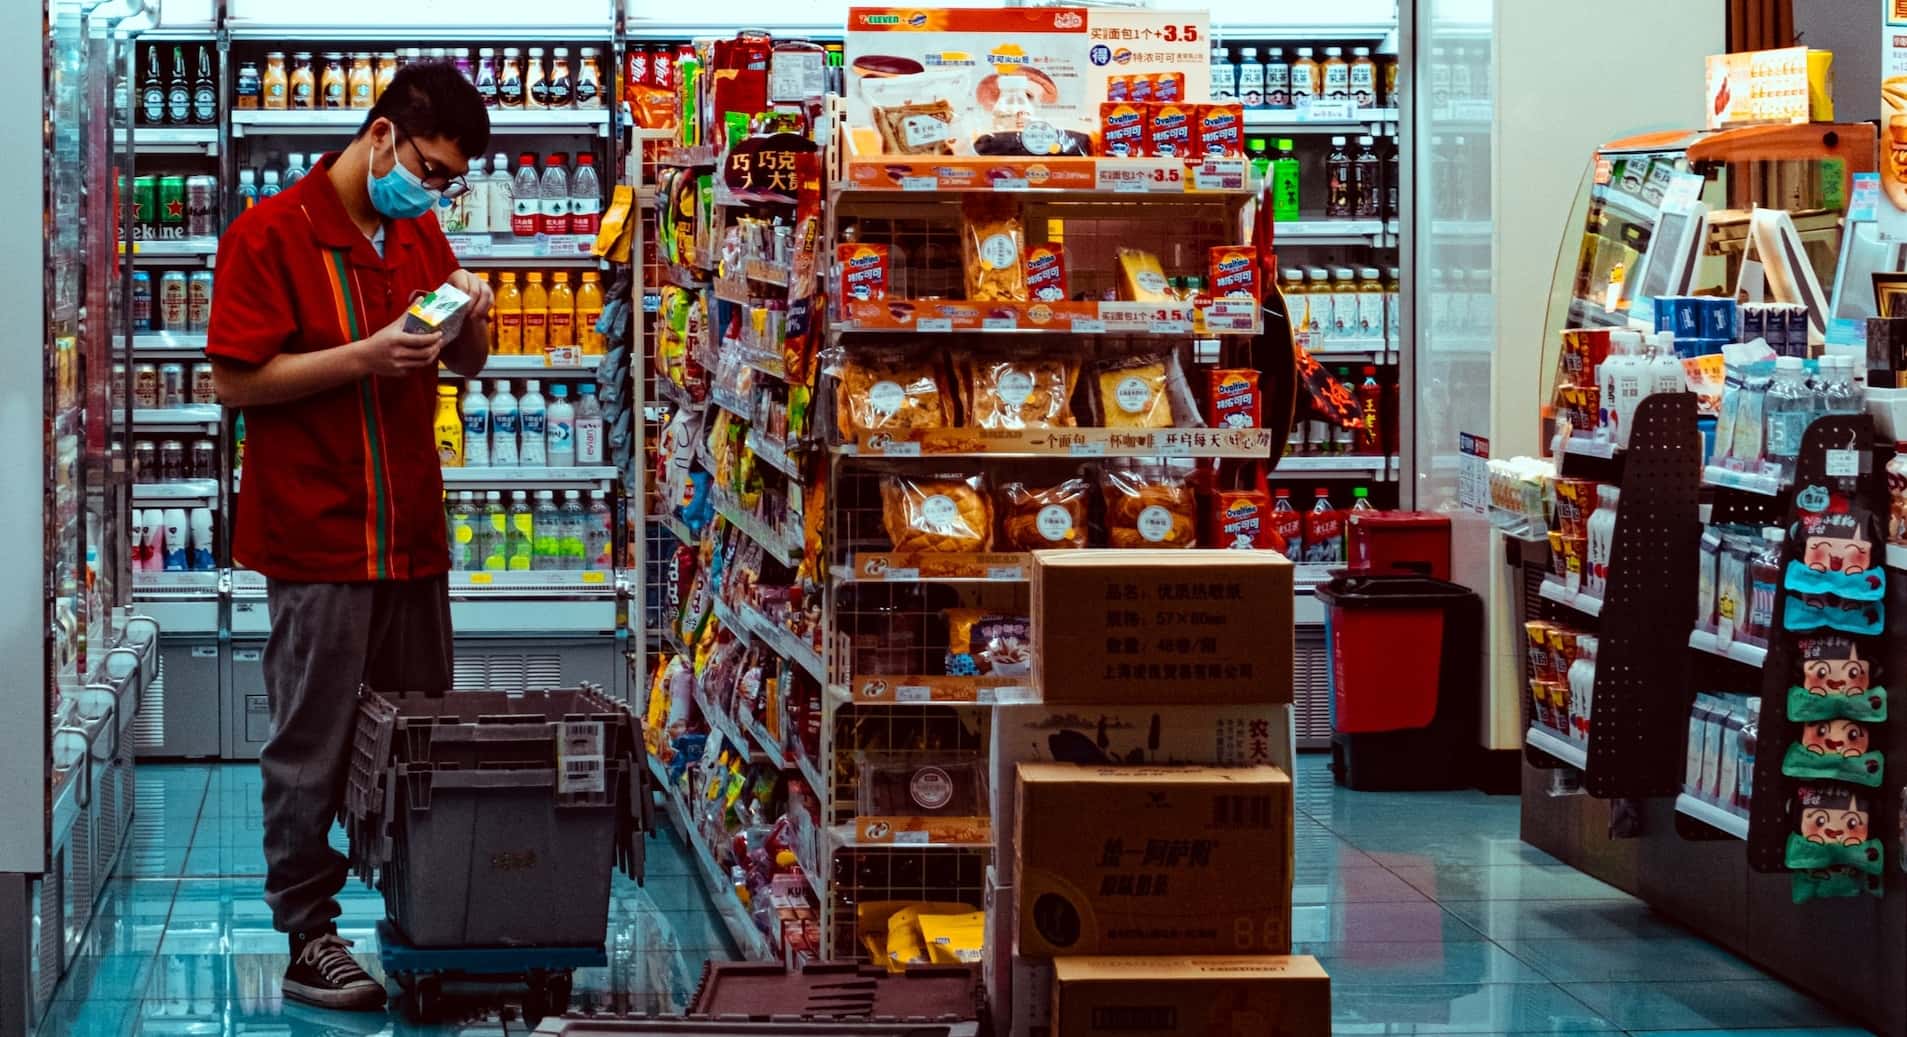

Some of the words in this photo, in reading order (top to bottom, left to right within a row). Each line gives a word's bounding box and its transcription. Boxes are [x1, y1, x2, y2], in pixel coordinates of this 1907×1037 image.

[1107, 113, 1140, 126] Ovaltine
[1154, 113, 1186, 126] Ovaltine
[1203, 114, 1236, 127] Ovaltine
[732, 153, 750, 171] 巧
[757, 150, 796, 171] 巧克
[849, 255, 881, 268] Ovaltine
[1027, 254, 1056, 269] Ovaltine
[1218, 258, 1249, 271] Ovaltine
[1218, 381, 1250, 395] Ovaltine
[1363, 398, 1377, 445] 王老
[1226, 505, 1258, 520] Ovaltine
[1247, 718, 1270, 763] 农夫
